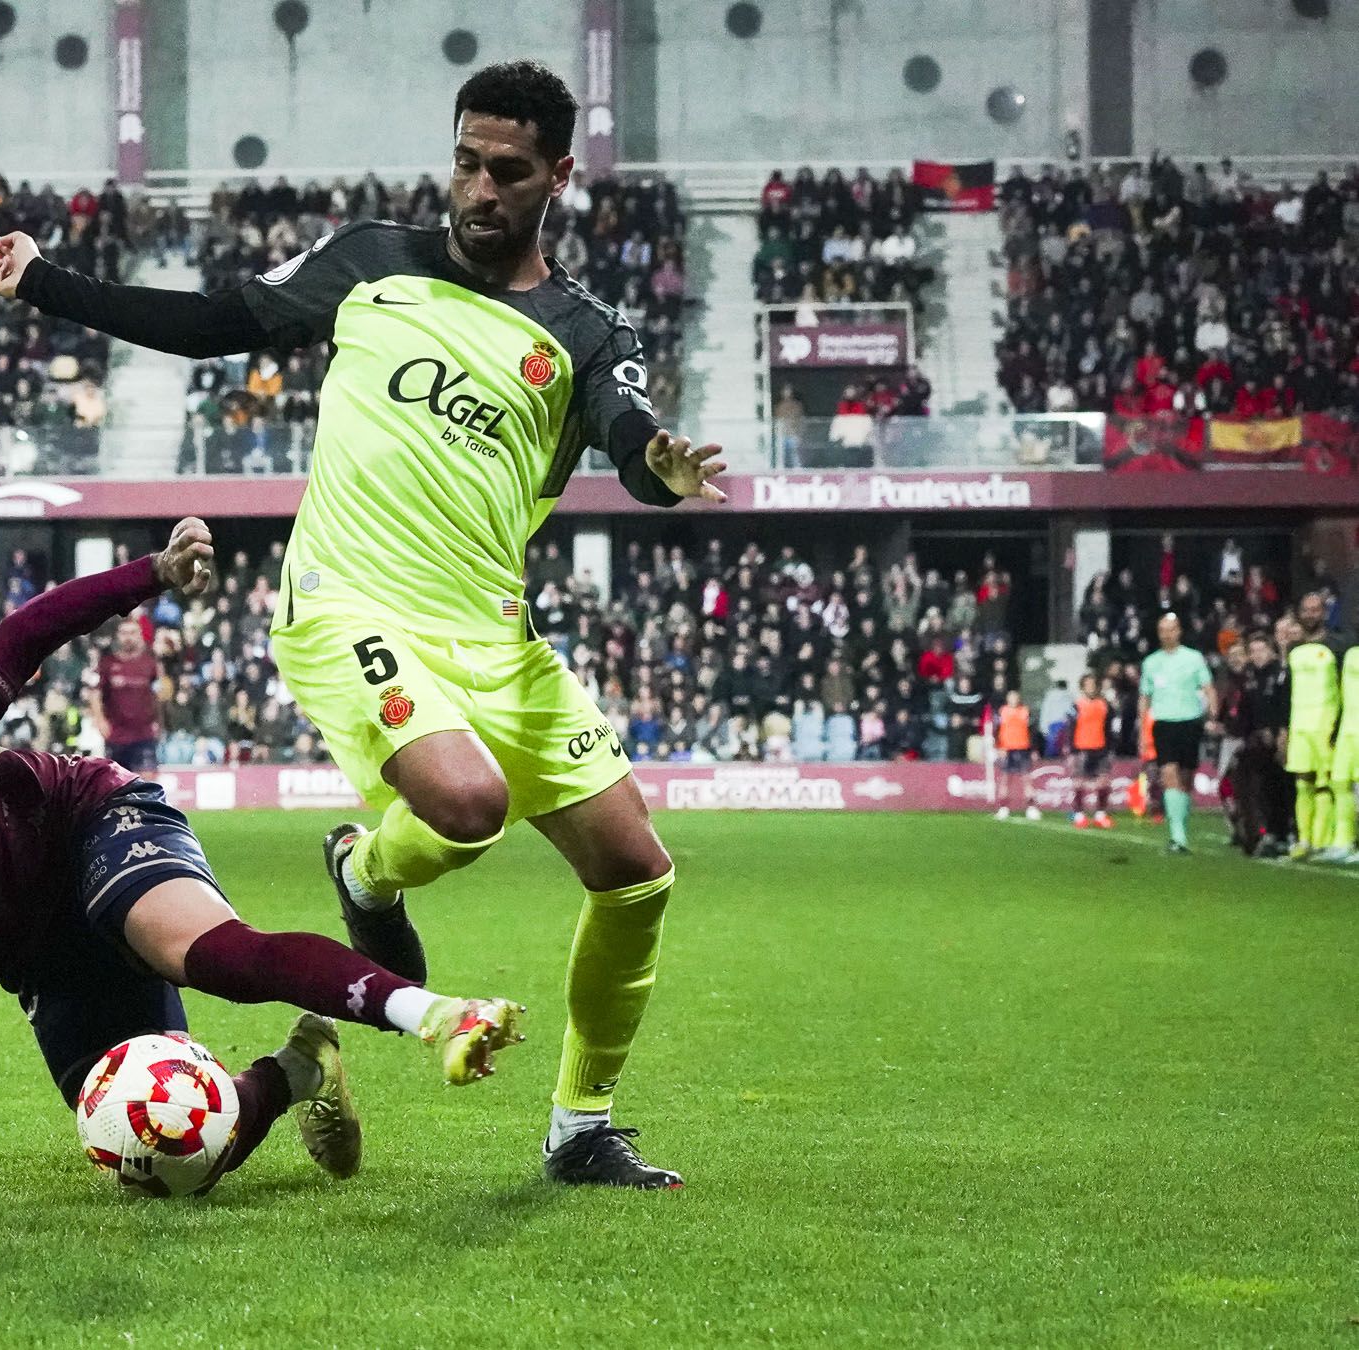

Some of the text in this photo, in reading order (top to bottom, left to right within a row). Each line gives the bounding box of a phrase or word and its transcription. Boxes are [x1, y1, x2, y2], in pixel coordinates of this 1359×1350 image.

[441, 426, 499, 458] by Taica
[753, 476, 841, 509] Diario
[869, 474, 1032, 508] Pontevedra
[353, 635, 399, 686] 5
